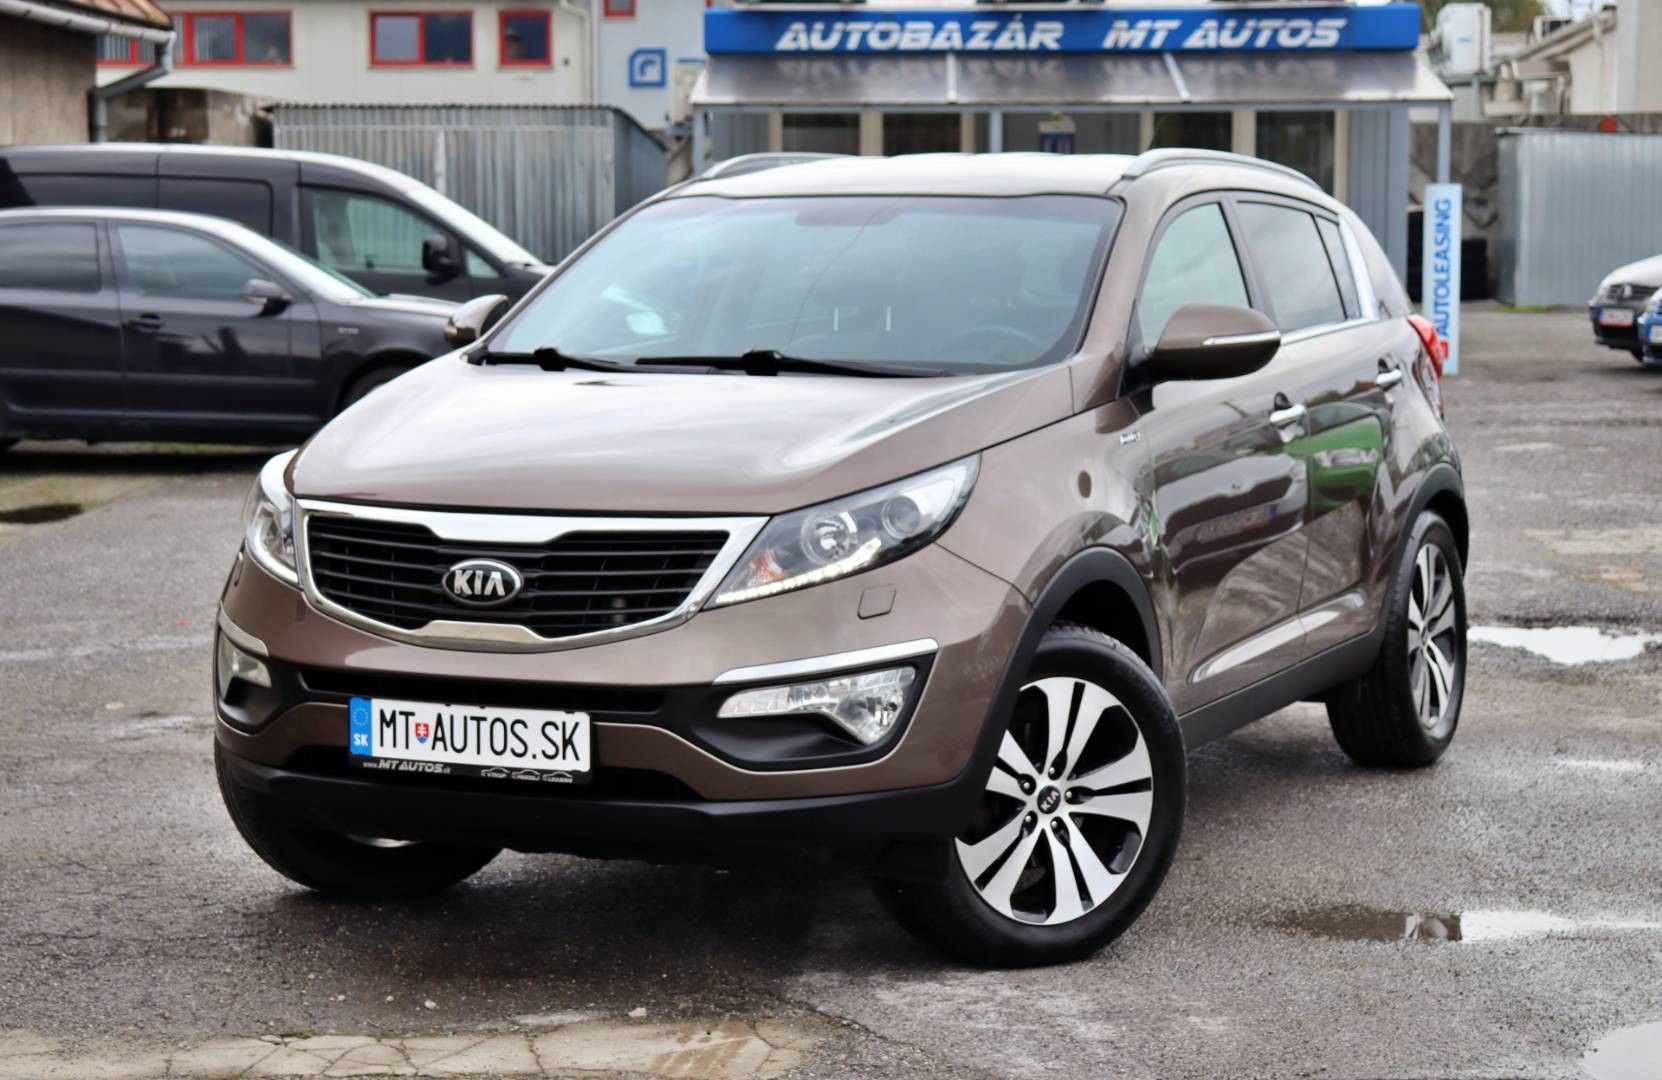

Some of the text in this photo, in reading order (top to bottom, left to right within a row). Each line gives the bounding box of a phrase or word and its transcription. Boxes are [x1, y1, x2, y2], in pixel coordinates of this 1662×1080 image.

[775, 14, 1348, 50] AUTOBAZÁR MT AUTOS
[1434, 198, 1451, 337] AUTOLEASING
[453, 569, 506, 596] KIA
[353, 733, 368, 746] SK
[379, 709, 580, 761] MT AUTOS.SK
[1040, 790, 1059, 811] KIA
